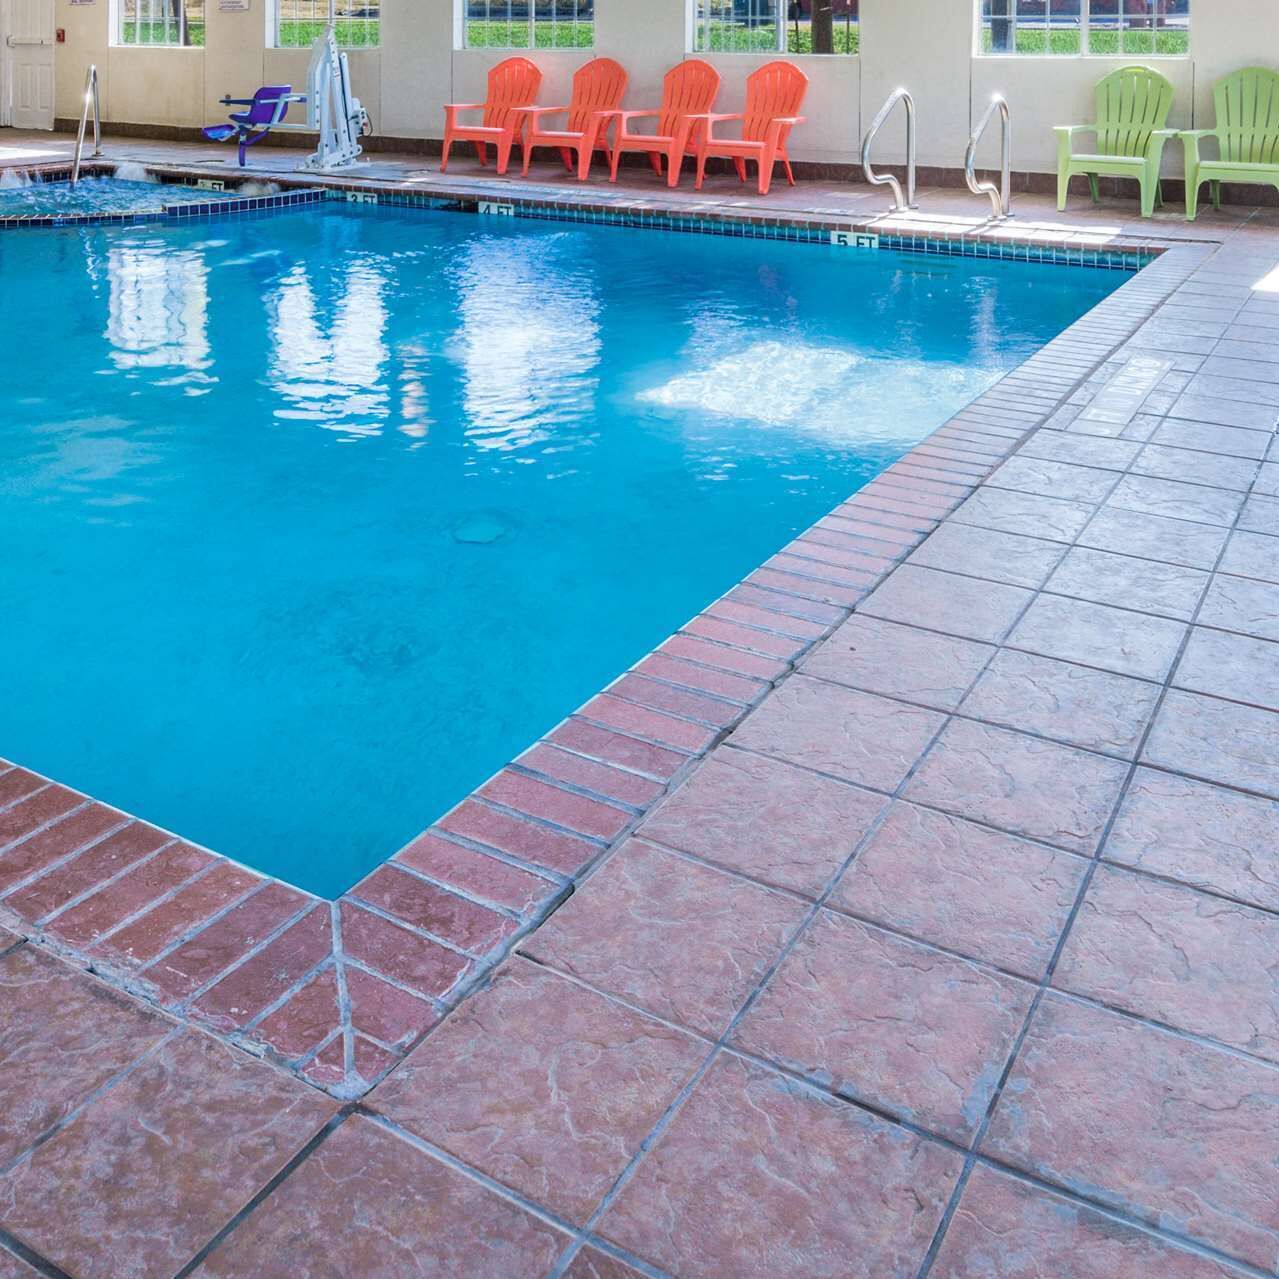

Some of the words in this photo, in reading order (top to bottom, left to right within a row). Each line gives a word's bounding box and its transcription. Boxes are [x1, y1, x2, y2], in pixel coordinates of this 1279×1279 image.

[497, 206, 511, 216] FT
[837, 234, 848, 246] 5
[856, 236, 875, 248] FT
